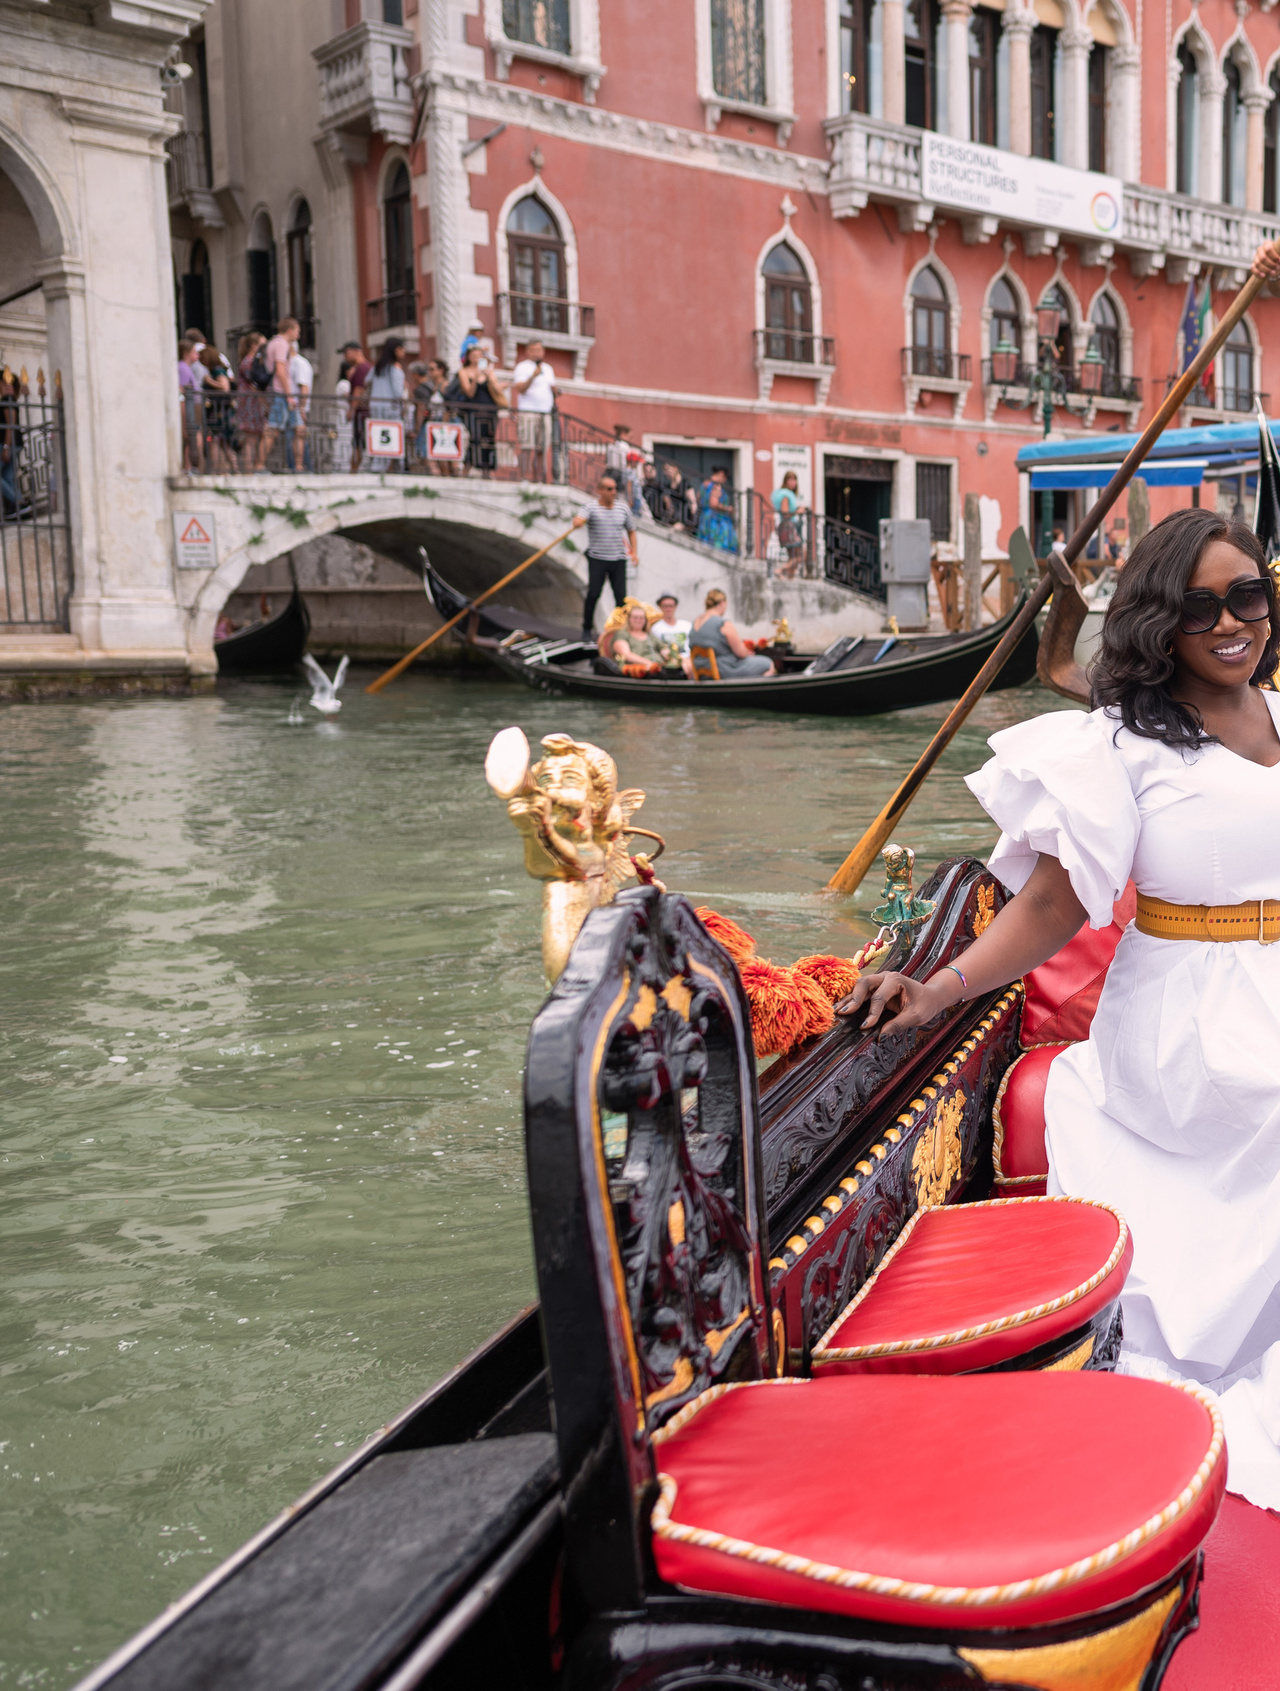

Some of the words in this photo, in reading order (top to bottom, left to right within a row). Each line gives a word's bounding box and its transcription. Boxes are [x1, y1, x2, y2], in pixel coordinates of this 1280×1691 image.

[928, 138, 1002, 173] PERSONAL
[928, 160, 1019, 194] STRUCTURES
[928, 179, 992, 206] Reflections
[379, 429, 391, 444] 5
